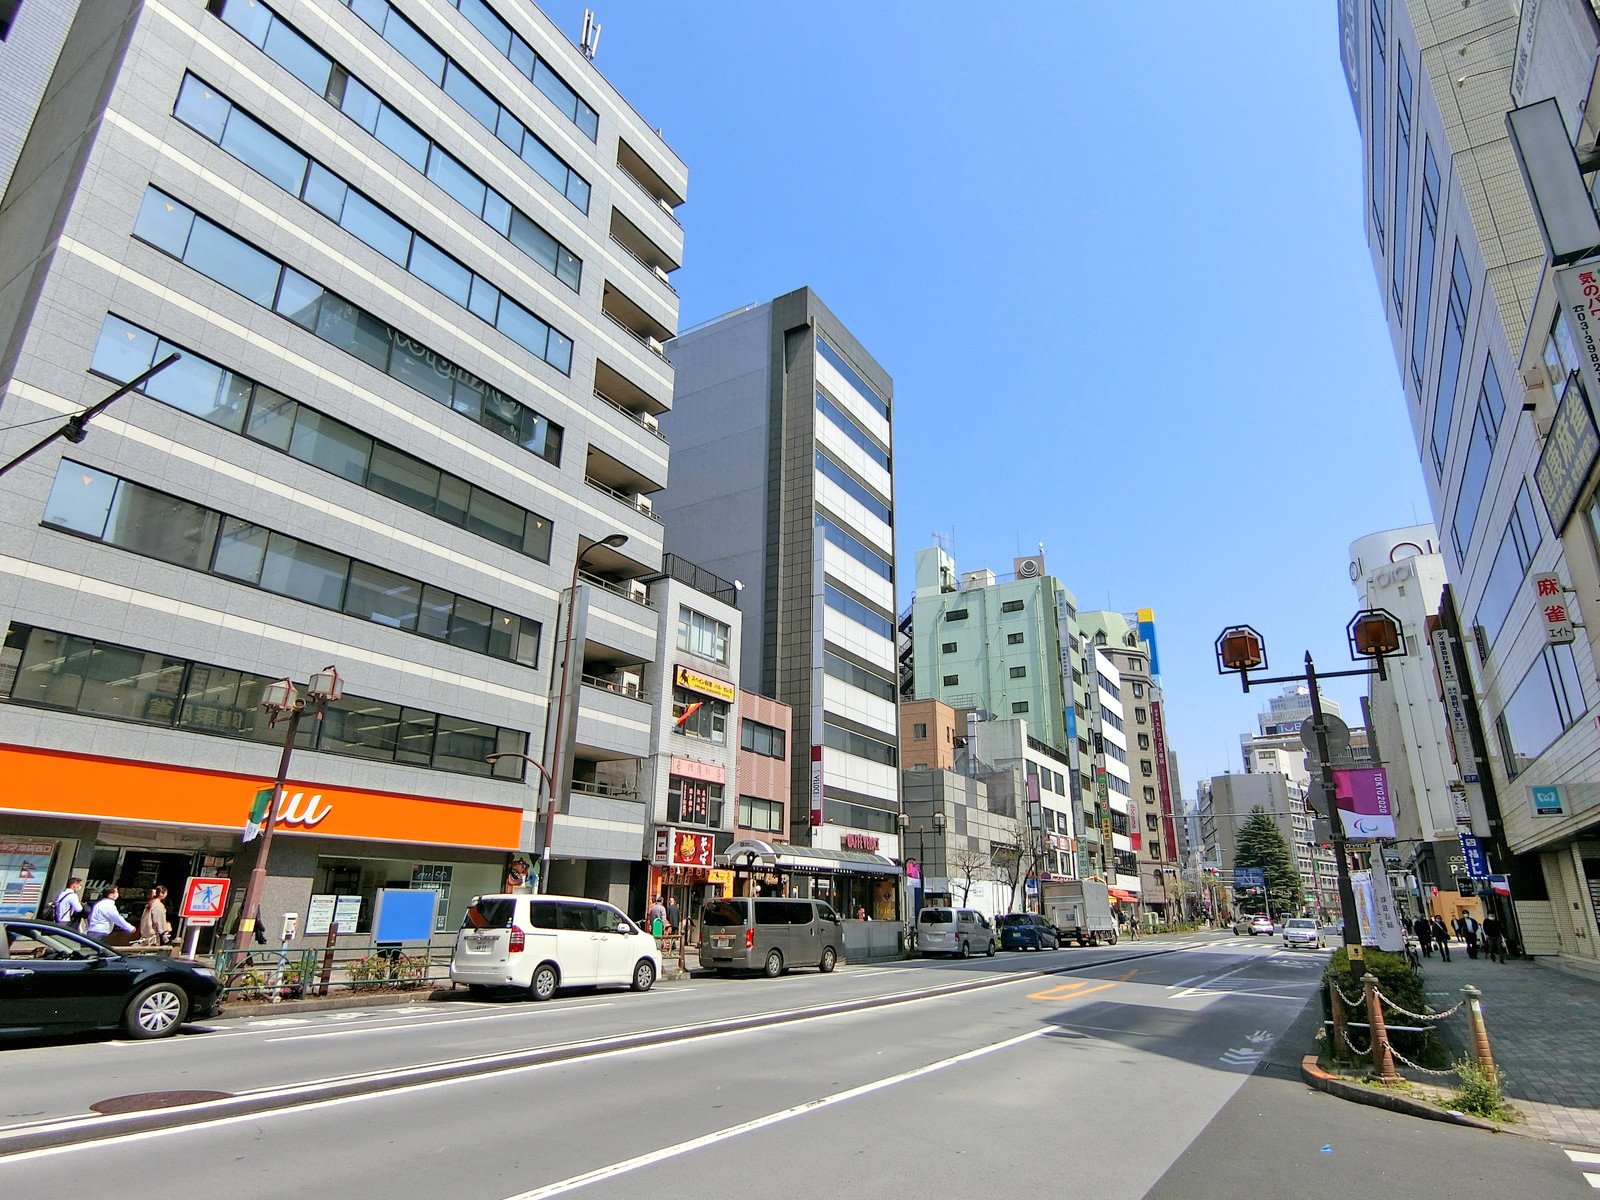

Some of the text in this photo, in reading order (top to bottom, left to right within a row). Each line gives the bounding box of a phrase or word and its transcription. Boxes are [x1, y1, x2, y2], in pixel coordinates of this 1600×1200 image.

[1537, 578, 1567, 623] 麻雀
[1549, 627, 1572, 638] エイト
[1465, 774, 1477, 782] 2F
[1374, 773, 1387, 813] TOKYO 2020
[1129, 804, 1137, 829] docomo
[1450, 864, 1458, 874] P
